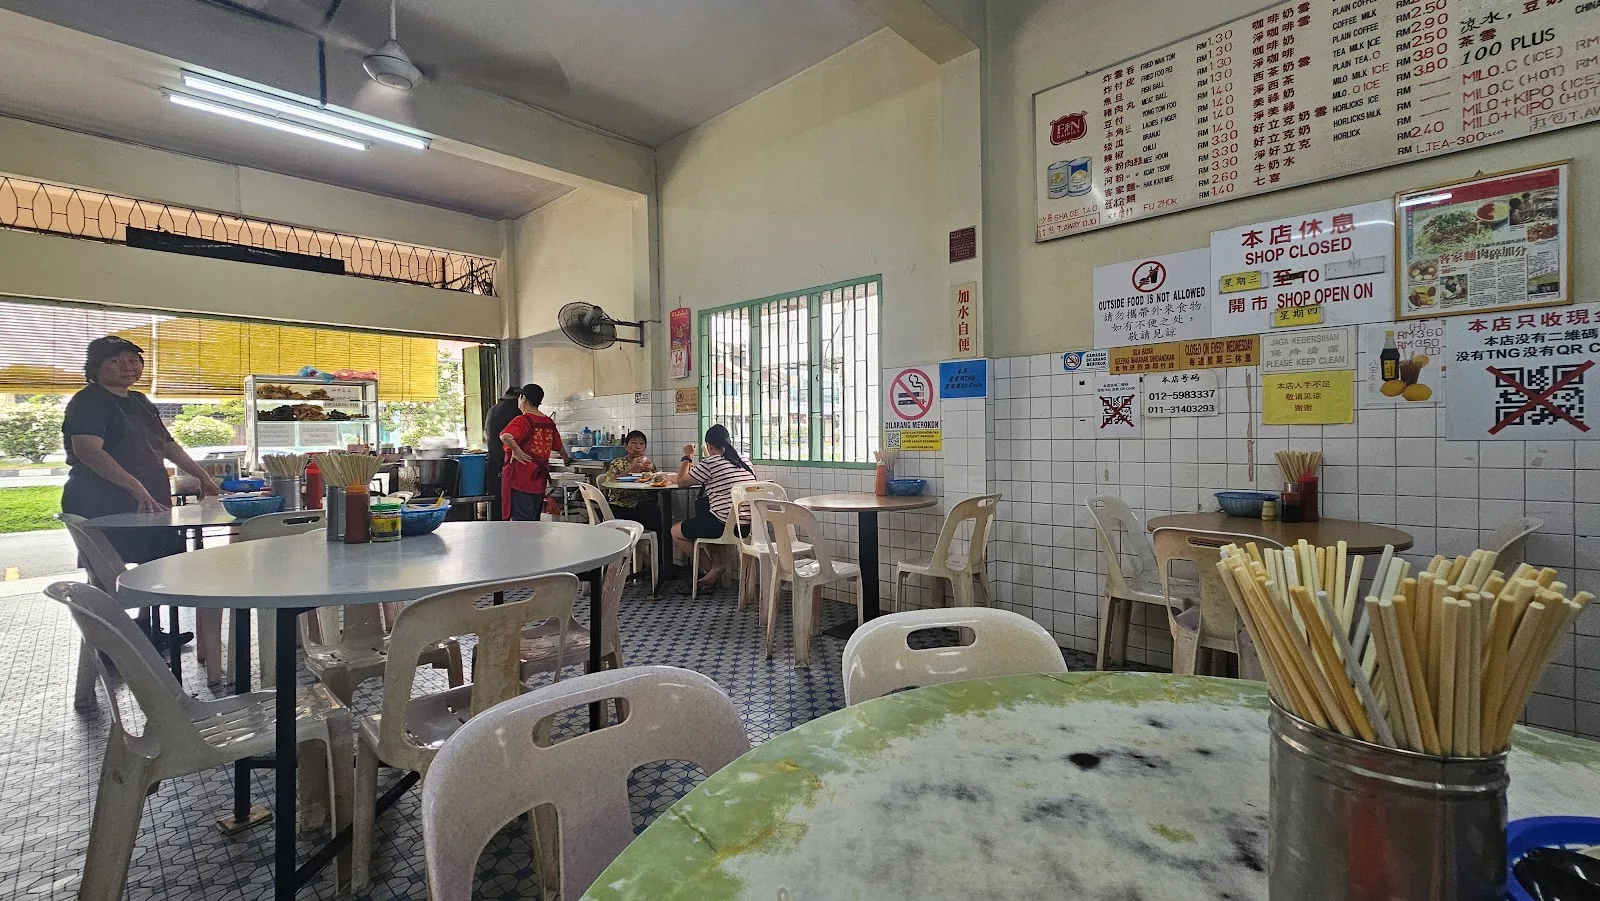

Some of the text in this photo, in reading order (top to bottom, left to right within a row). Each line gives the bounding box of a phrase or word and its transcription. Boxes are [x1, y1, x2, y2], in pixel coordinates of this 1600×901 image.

[1333, 4, 1350, 16] PLAIN
[1396, 0, 1447, 23] RM 2.50
[1333, 9, 1377, 30] COFFEE MILK
[1396, 13, 1448, 38] RM 2.90
[1333, 22, 1379, 43] PLAIN COFFEE
[1196, 30, 1232, 51] RM 1.30
[1252, 35, 1294, 56] 咖啡奶
[1396, 28, 1448, 52] RM 2.50
[1333, 36, 1381, 58] TEA MILK ICE
[1460, 28, 1556, 66] 100 PLUS
[1523, 36, 1600, 66] (ICE) RM
[1196, 54, 1207, 63] RM
[1396, 43, 1448, 68] RM 3.80
[1140, 60, 1153, 70] FRIED
[1197, 67, 1208, 76] RM
[1333, 60, 1351, 71] PLAIN
[1396, 58, 1448, 82] RM 3.80
[1519, 55, 1598, 86] (HOT) RM
[1332, 63, 1389, 85] MILO MILK ICE
[1141, 81, 1164, 94] FISH BALL
[1198, 79, 1208, 88] RM
[1364, 79, 1380, 91] ICE
[1156, 92, 1168, 101] BALL
[1198, 91, 1208, 100] RM
[1396, 86, 1411, 96] RM
[1167, 101, 1177, 110] FOO
[1198, 104, 1208, 113] RM
[1333, 95, 1379, 113] HORLICKS ICE
[1397, 101, 1412, 112] RM
[1104, 116, 1124, 129] 豆付
[1198, 116, 1208, 125] RM
[1333, 113, 1365, 127] HORLICKS
[1397, 116, 1412, 126] RM
[1056, 129, 1080, 139] DAIRIES
[1198, 129, 1209, 137] RM
[1253, 124, 1311, 148] 好立克奶
[1333, 129, 1361, 141] HORLICK
[1397, 121, 1444, 141] RM 2.40
[1198, 130, 1238, 150] RM 3.30
[1198, 143, 1238, 162] RM 3.30
[1398, 145, 1413, 156] RM
[1144, 156, 1153, 164] MEE
[1198, 156, 1238, 175] RM 3.30
[1254, 156, 1295, 173] 牛奶水
[1165, 175, 1174, 183] MEE
[1198, 171, 1238, 187] RM 2.60
[1254, 173, 1280, 186] 七喜
[1199, 183, 1234, 199] RM 1.40
[1144, 203, 1154, 211] FU
[1241, 213, 1356, 248] 本店休息
[1245, 237, 1352, 266] SHOP CLOSED
[1223, 275, 1259, 288] 星期三
[1273, 269, 1292, 288] 至
[1300, 269, 1319, 284] TO
[1098, 287, 1206, 311] OUTSIDE FOOD IS NOT ALLOWED
[1278, 282, 1373, 309] SHOP OPEN ON
[1228, 295, 1268, 314] 開市
[957, 289, 970, 352] 加水自便
[1279, 308, 1318, 321] 星期四
[1270, 333, 1340, 347] JAGA KEBERSIHAN
[1185, 338, 1253, 356] CLOSED ON EVERY WEDNESDAY
[675, 352, 683, 363] 14
[1266, 356, 1345, 368] PLEASE KEEP CLEAN
[1162, 374, 1200, 384] 本店号码
[1277, 381, 1331, 390] 本店人手不足
[1149, 390, 1216, 400] 012-5983337
[1285, 393, 1322, 401] 敬请见谅
[1148, 404, 1215, 414] 011-31403293
[1294, 404, 1313, 412] 谢谢
[885, 421, 939, 429] DILARANG MEROKOK
